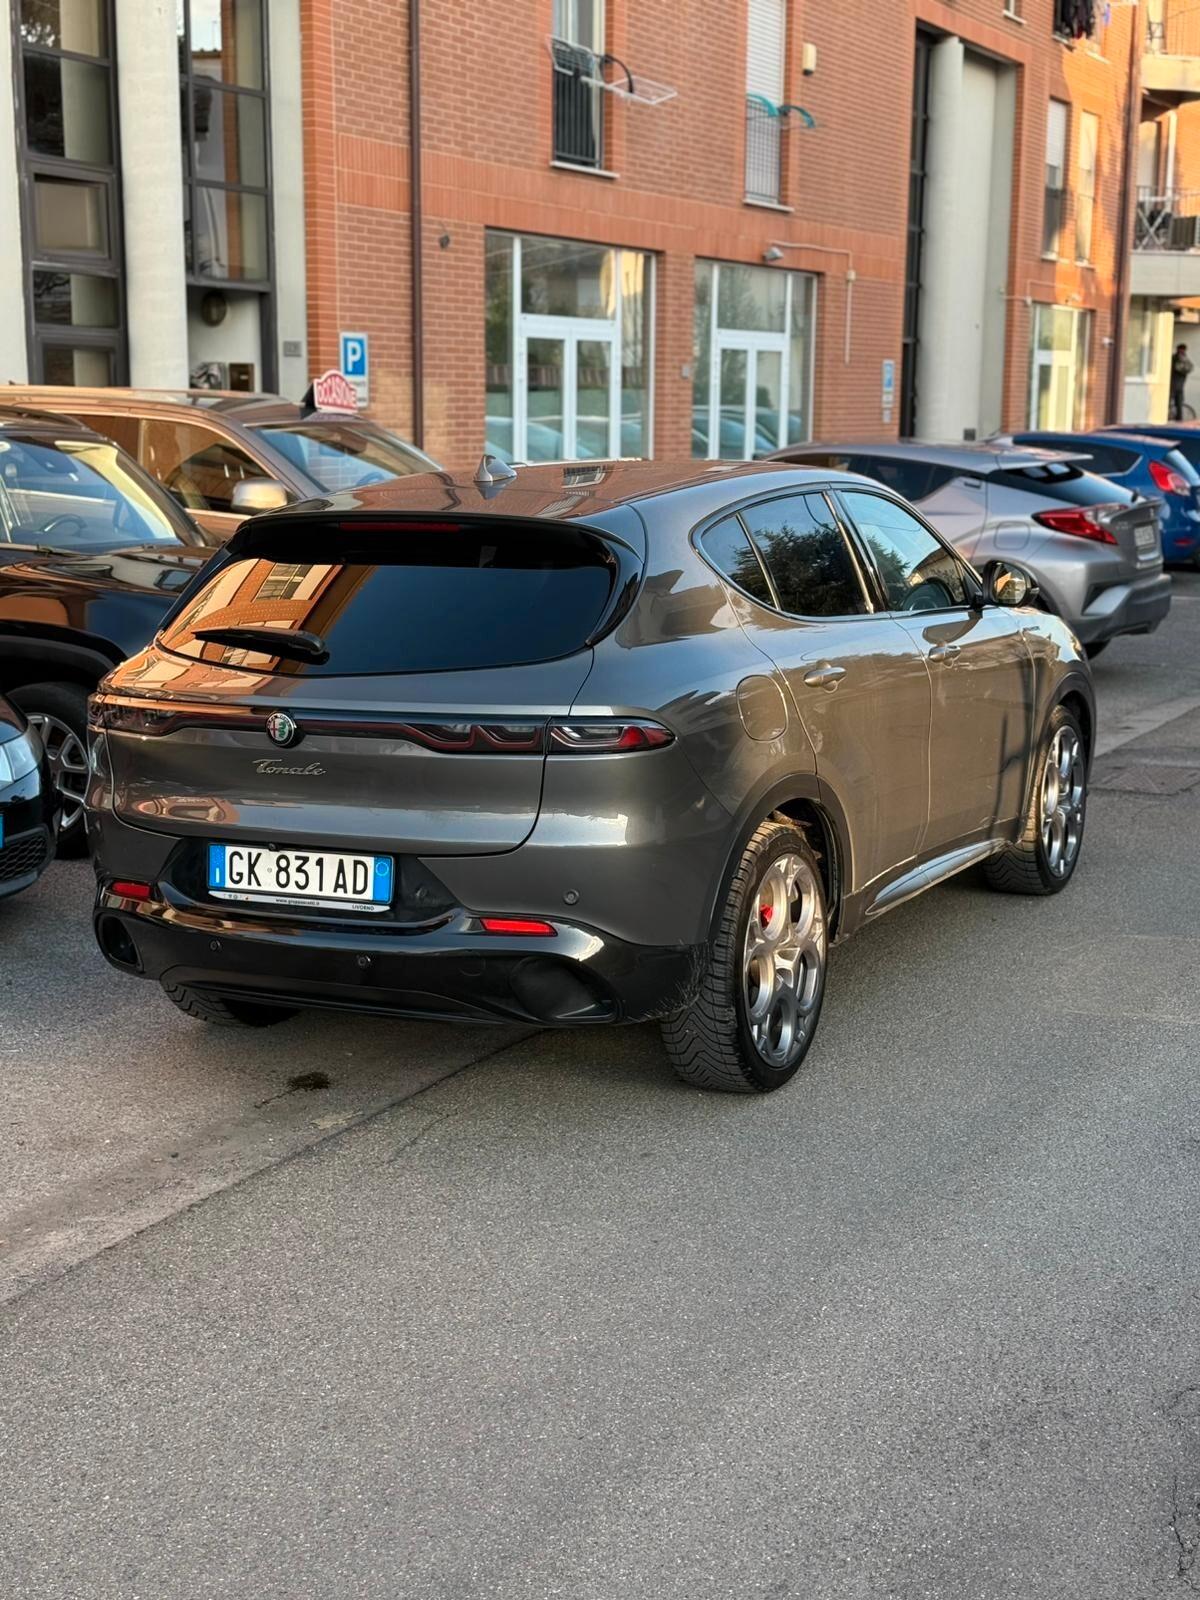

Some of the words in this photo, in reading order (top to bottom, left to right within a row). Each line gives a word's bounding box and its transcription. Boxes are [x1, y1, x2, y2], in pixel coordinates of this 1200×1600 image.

[346, 340, 362, 373] P
[252, 758, 327, 776] Tonale
[228, 850, 262, 887] GK
